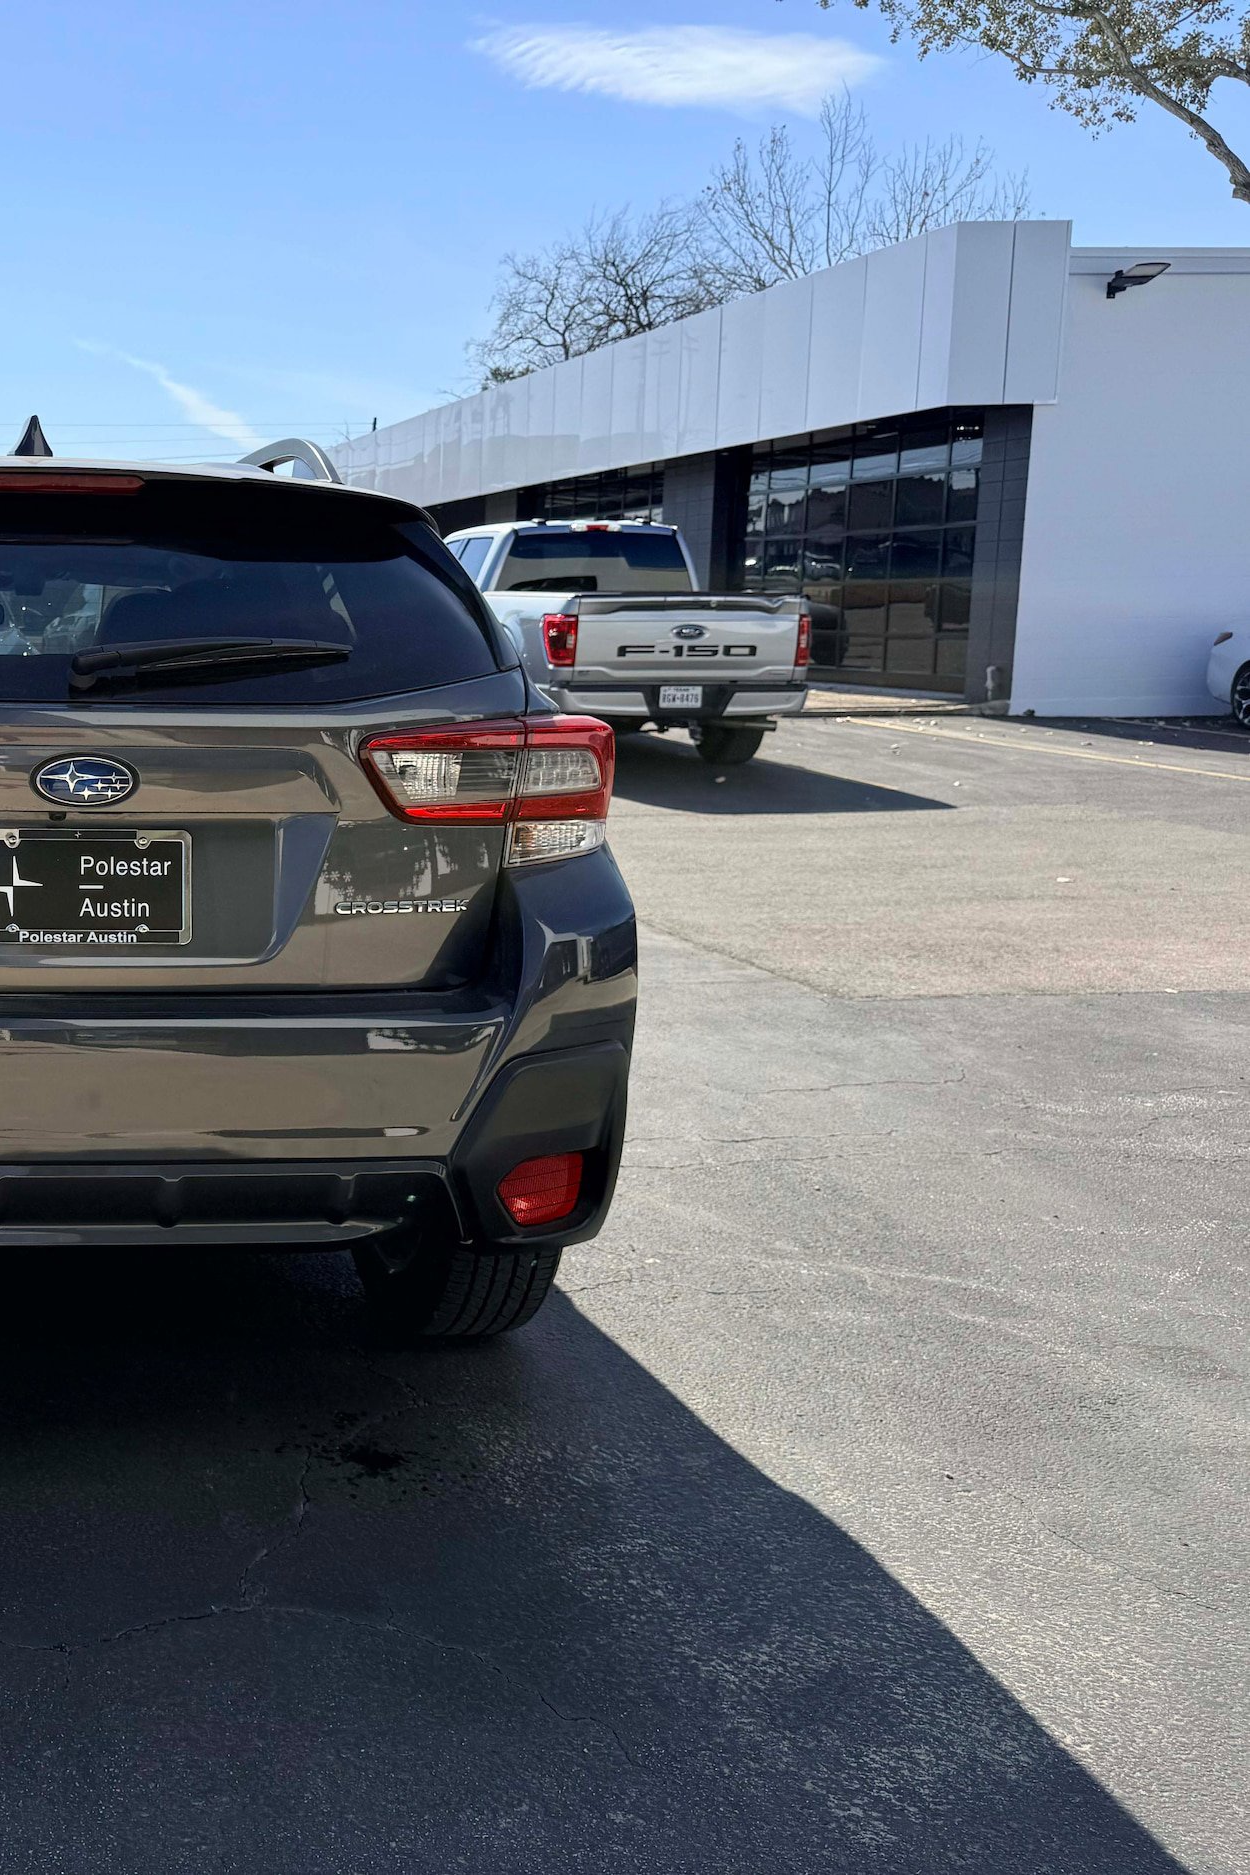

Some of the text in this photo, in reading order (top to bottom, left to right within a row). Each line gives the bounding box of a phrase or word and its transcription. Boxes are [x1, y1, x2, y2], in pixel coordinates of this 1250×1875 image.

[617, 645, 757, 657] F-150
[80, 856, 172, 876] Polestar
[79, 898, 150, 917] Austin
[335, 899, 470, 915] CROSSTREK
[19, 931, 138, 943] Polestar Austin
